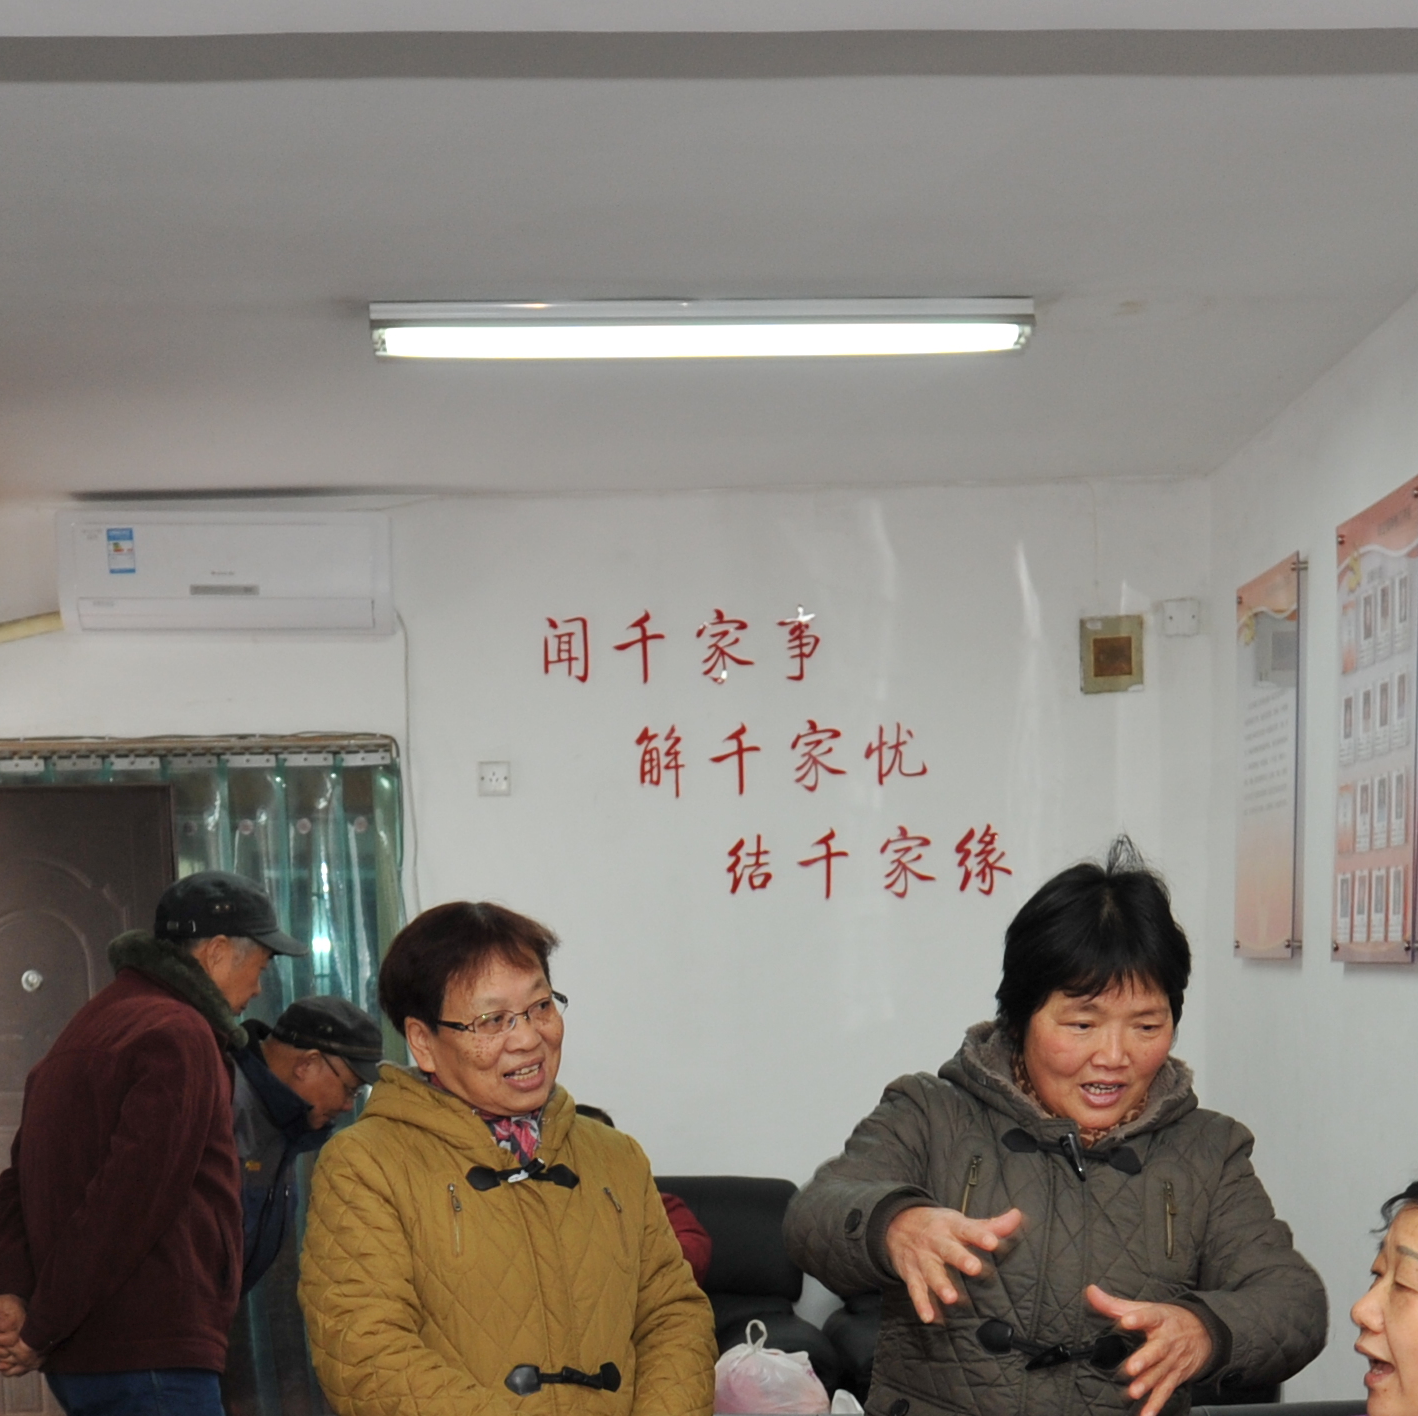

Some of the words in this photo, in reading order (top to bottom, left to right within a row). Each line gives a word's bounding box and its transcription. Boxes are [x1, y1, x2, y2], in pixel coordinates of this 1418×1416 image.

[542, 604, 821, 684] 闻千家事
[635, 719, 928, 799] 解千家忧
[726, 823, 1013, 899] 结千家缘
